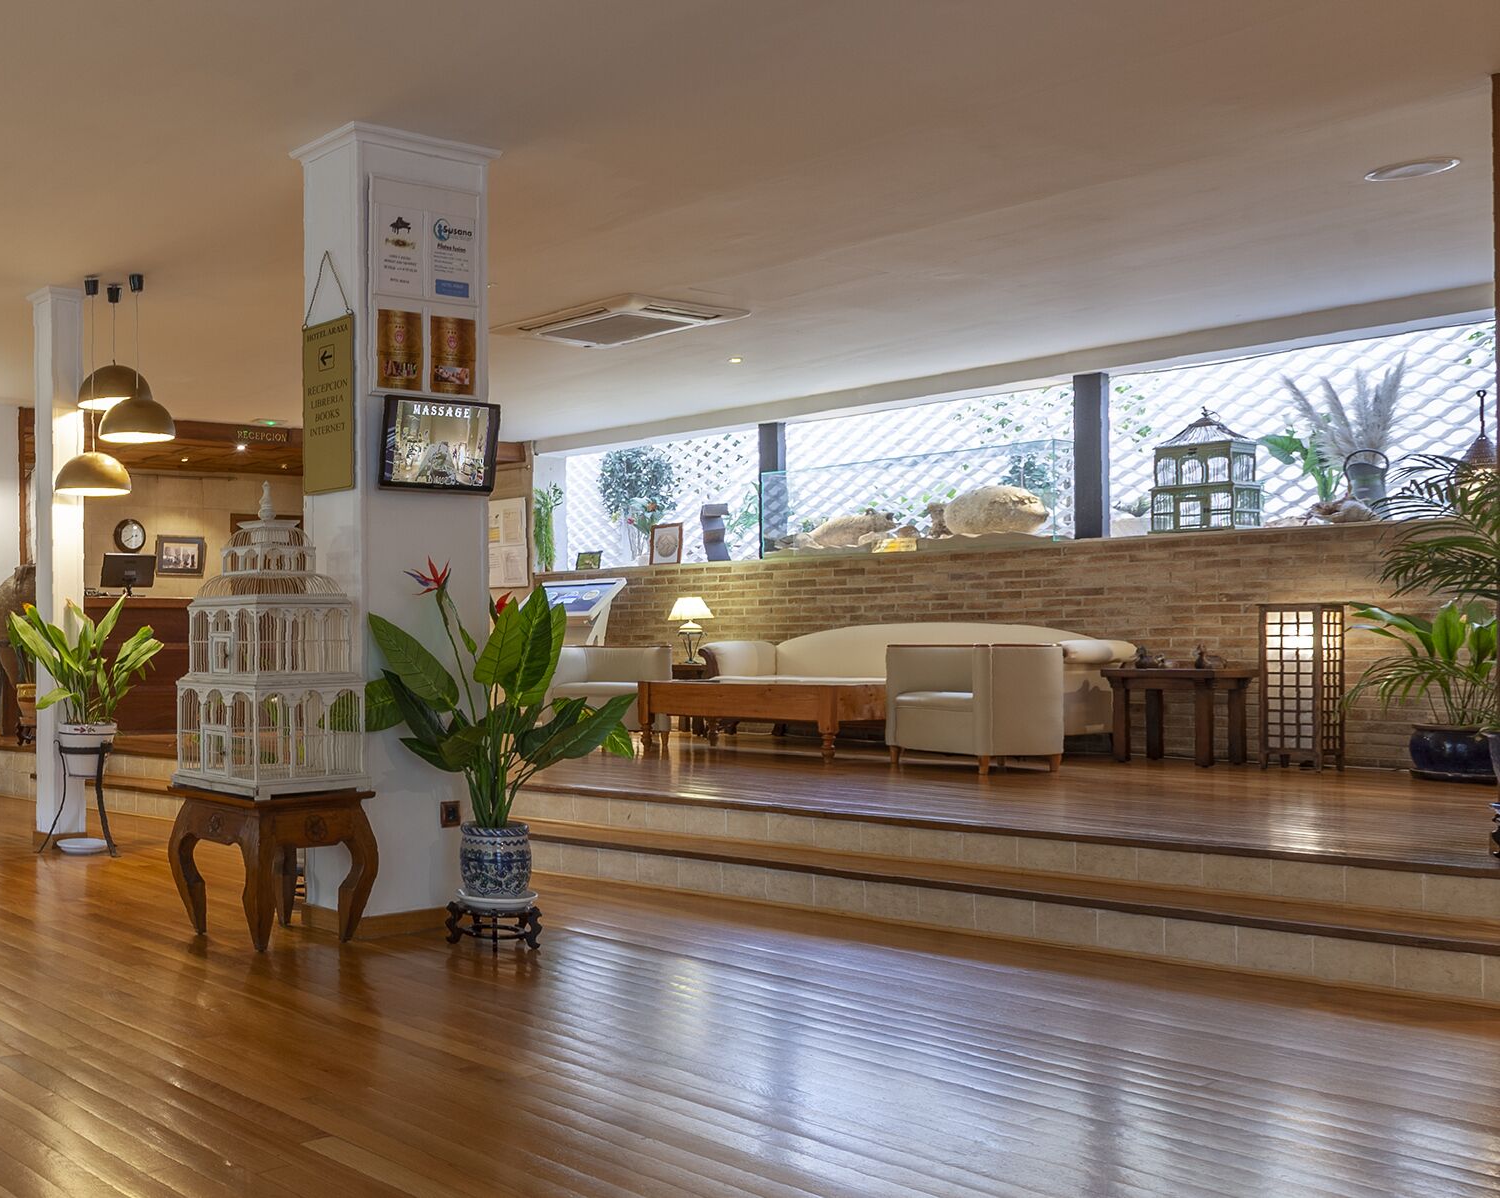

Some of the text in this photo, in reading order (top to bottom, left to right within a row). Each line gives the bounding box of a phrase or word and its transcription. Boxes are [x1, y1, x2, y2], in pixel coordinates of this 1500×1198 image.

[443, 225, 473, 237] Susana
[306, 323, 348, 343] HOTEL ARAXA
[307, 378, 348, 396] RECEPCION
[310, 394, 344, 409] LIBRERIA
[315, 408, 340, 422] BOOKS
[412, 404, 470, 418] MASSAGE
[237, 430, 288, 442] RECEPCION
[309, 422, 345, 437] INTERNET
